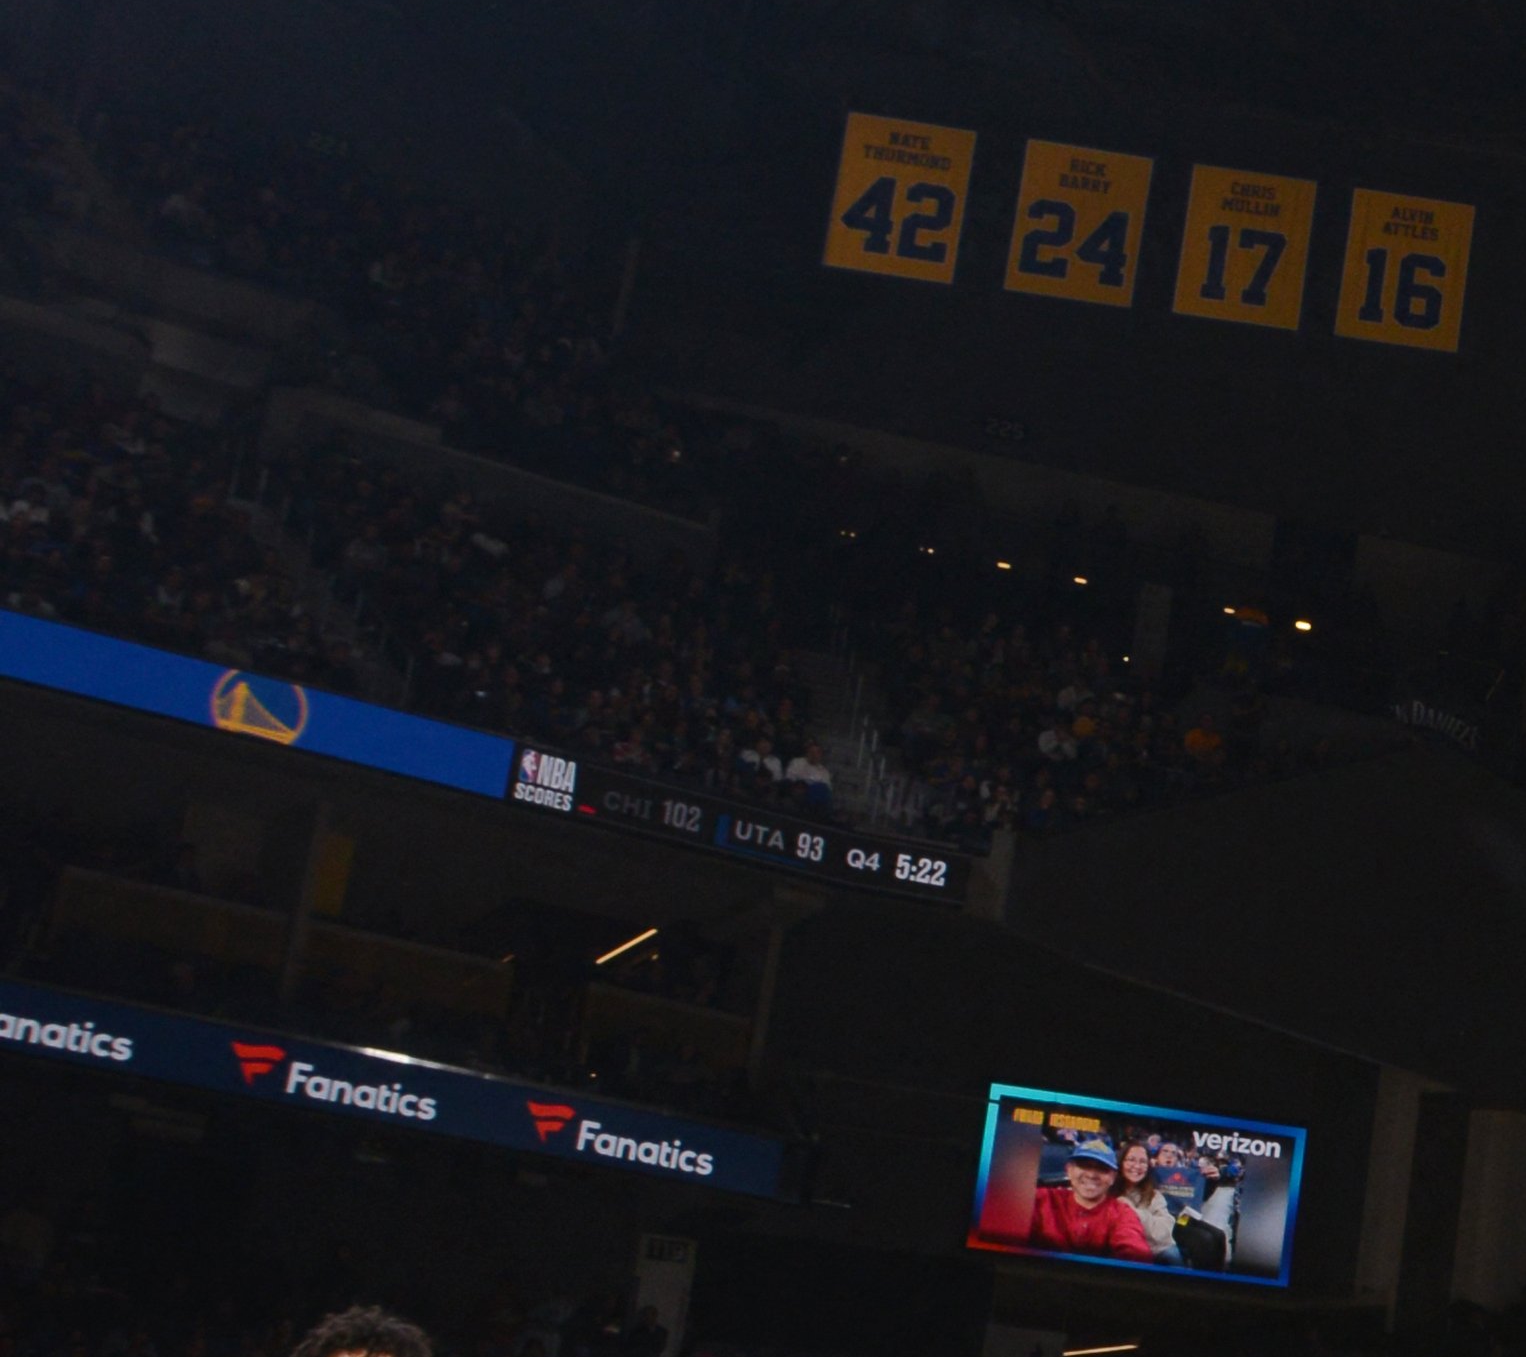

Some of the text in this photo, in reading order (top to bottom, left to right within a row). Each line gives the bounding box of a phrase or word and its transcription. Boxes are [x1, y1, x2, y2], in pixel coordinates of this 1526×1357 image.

[1231, 182, 1276, 201] CHRIS
[1391, 206, 1434, 225] ALVIN
[841, 176, 956, 264] 42
[1018, 199, 1130, 288] 24
[1382, 222, 1439, 241] ATTLES
[1200, 224, 1288, 306] 17
[1358, 247, 1446, 330] 16
[514, 781, 573, 812] SCORES
[537, 754, 577, 791] NBA
[662, 799, 948, 887] 102 UTA 93 Q4 5:22
[285, 1062, 437, 1120] Fanatics
[576, 1120, 714, 1176] Fanatics
[1193, 1129, 1280, 1160] verizon
